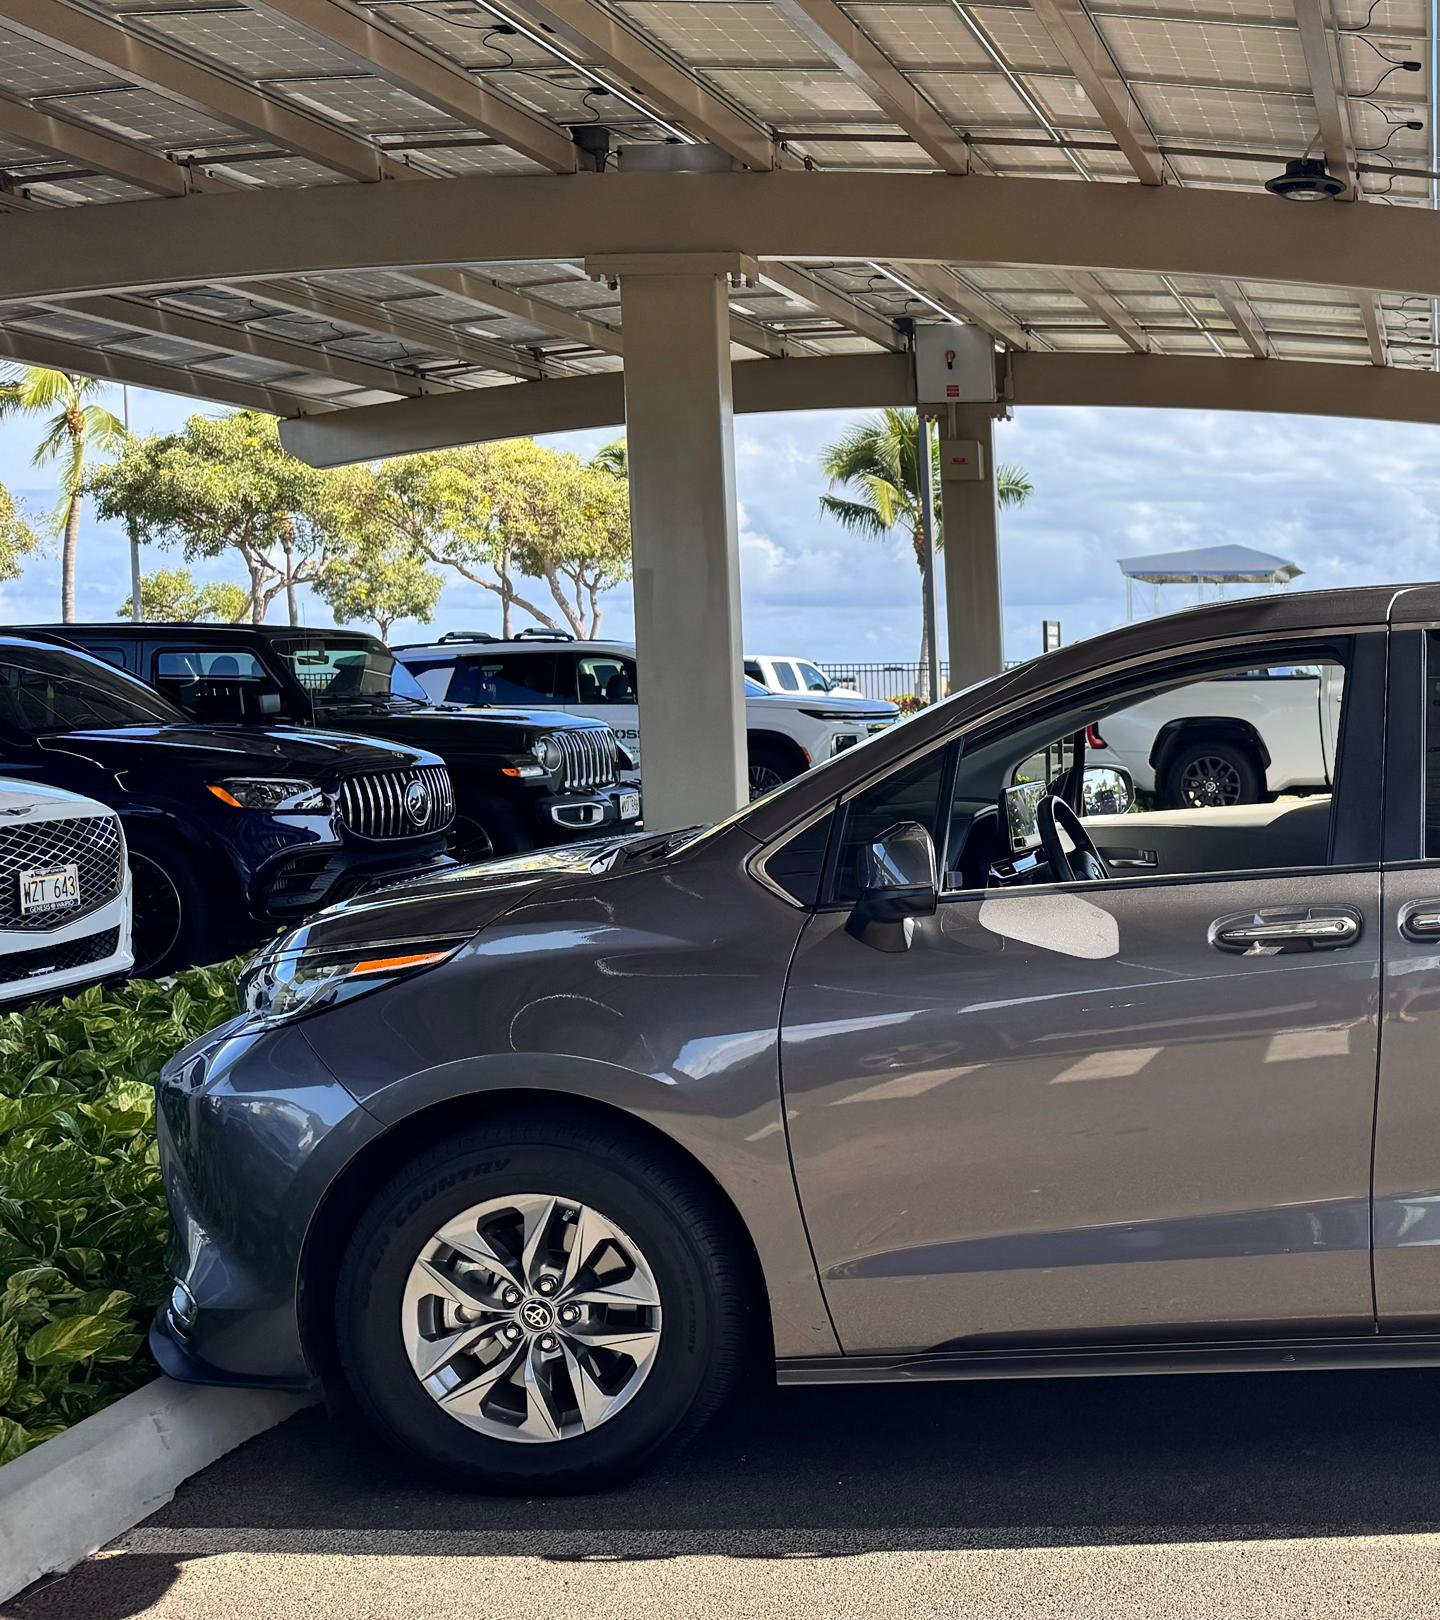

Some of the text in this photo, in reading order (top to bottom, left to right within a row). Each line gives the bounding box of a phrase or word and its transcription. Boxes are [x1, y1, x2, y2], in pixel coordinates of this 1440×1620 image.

[23, 876, 76, 904] WZT 643
[394, 1157, 511, 1229] COUNTRY
